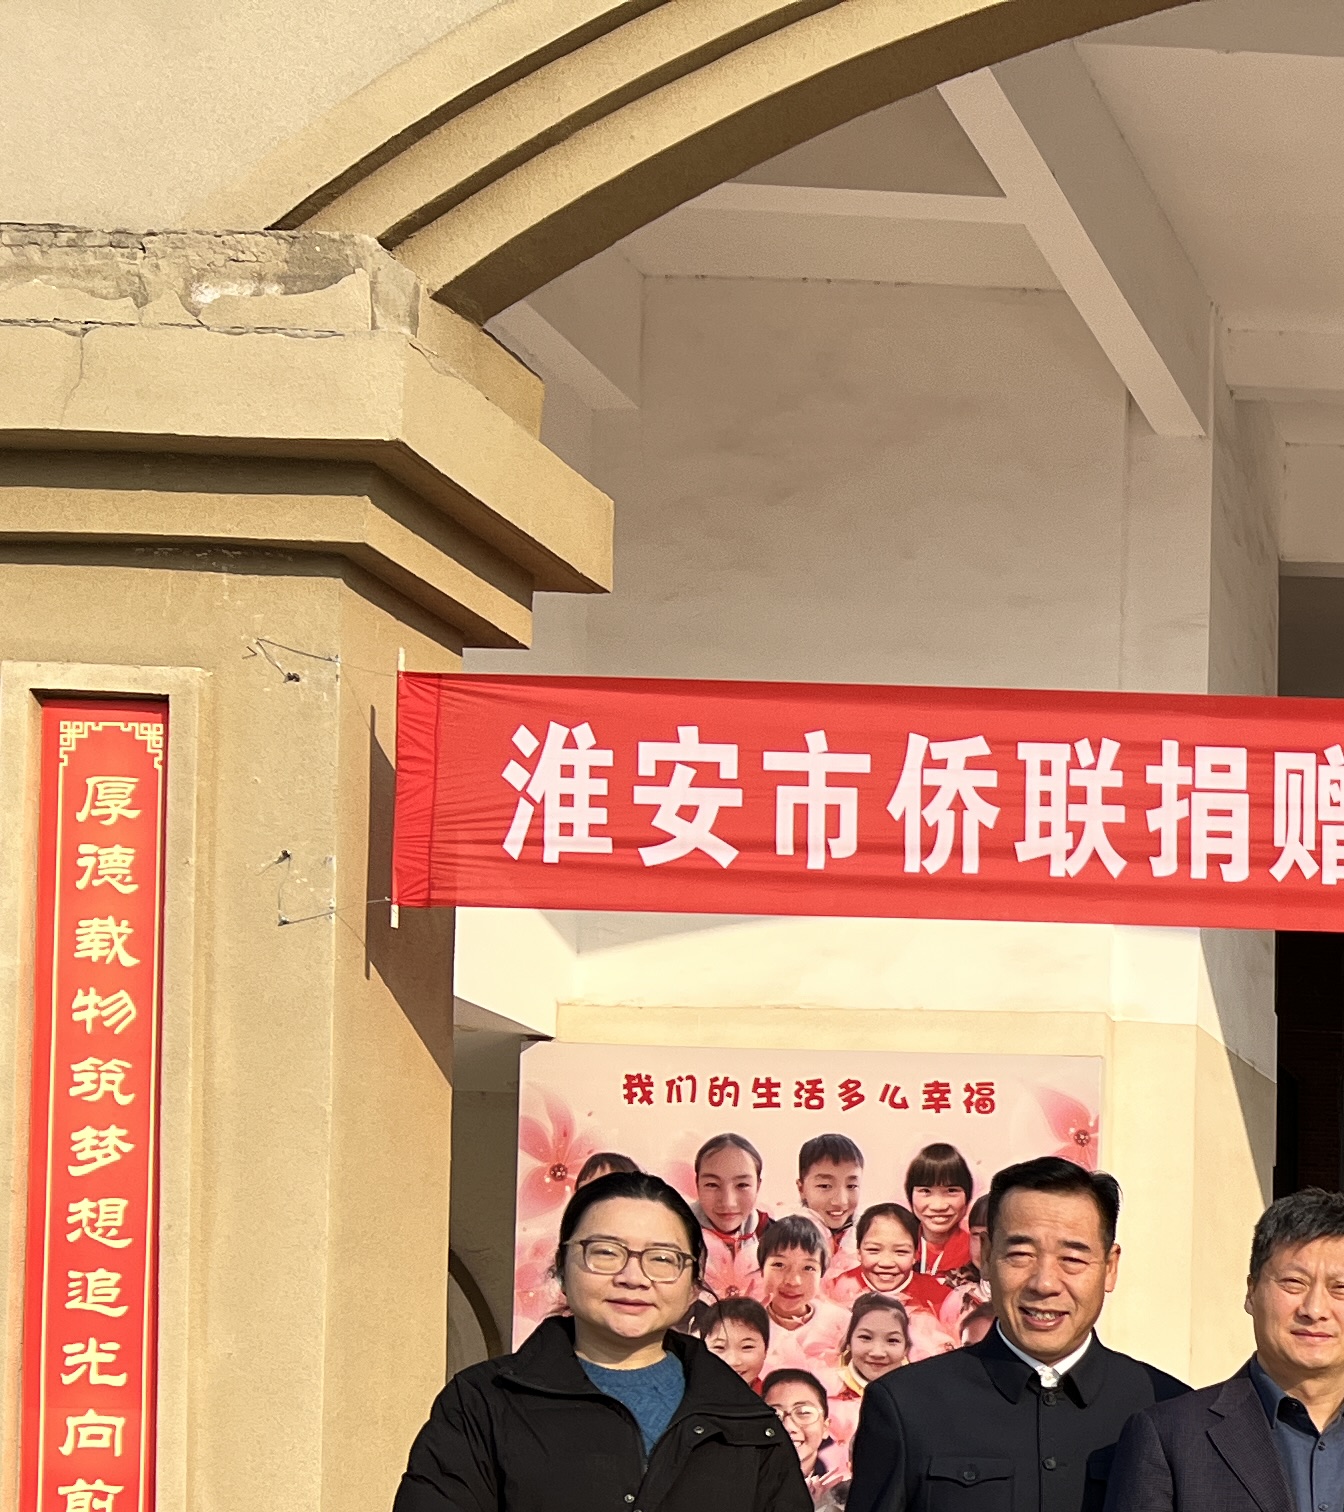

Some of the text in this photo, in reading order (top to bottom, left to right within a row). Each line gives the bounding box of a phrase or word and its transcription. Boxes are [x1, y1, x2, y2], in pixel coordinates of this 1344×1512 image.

[622, 1073, 997, 1115] 我们的生活多么幸福
